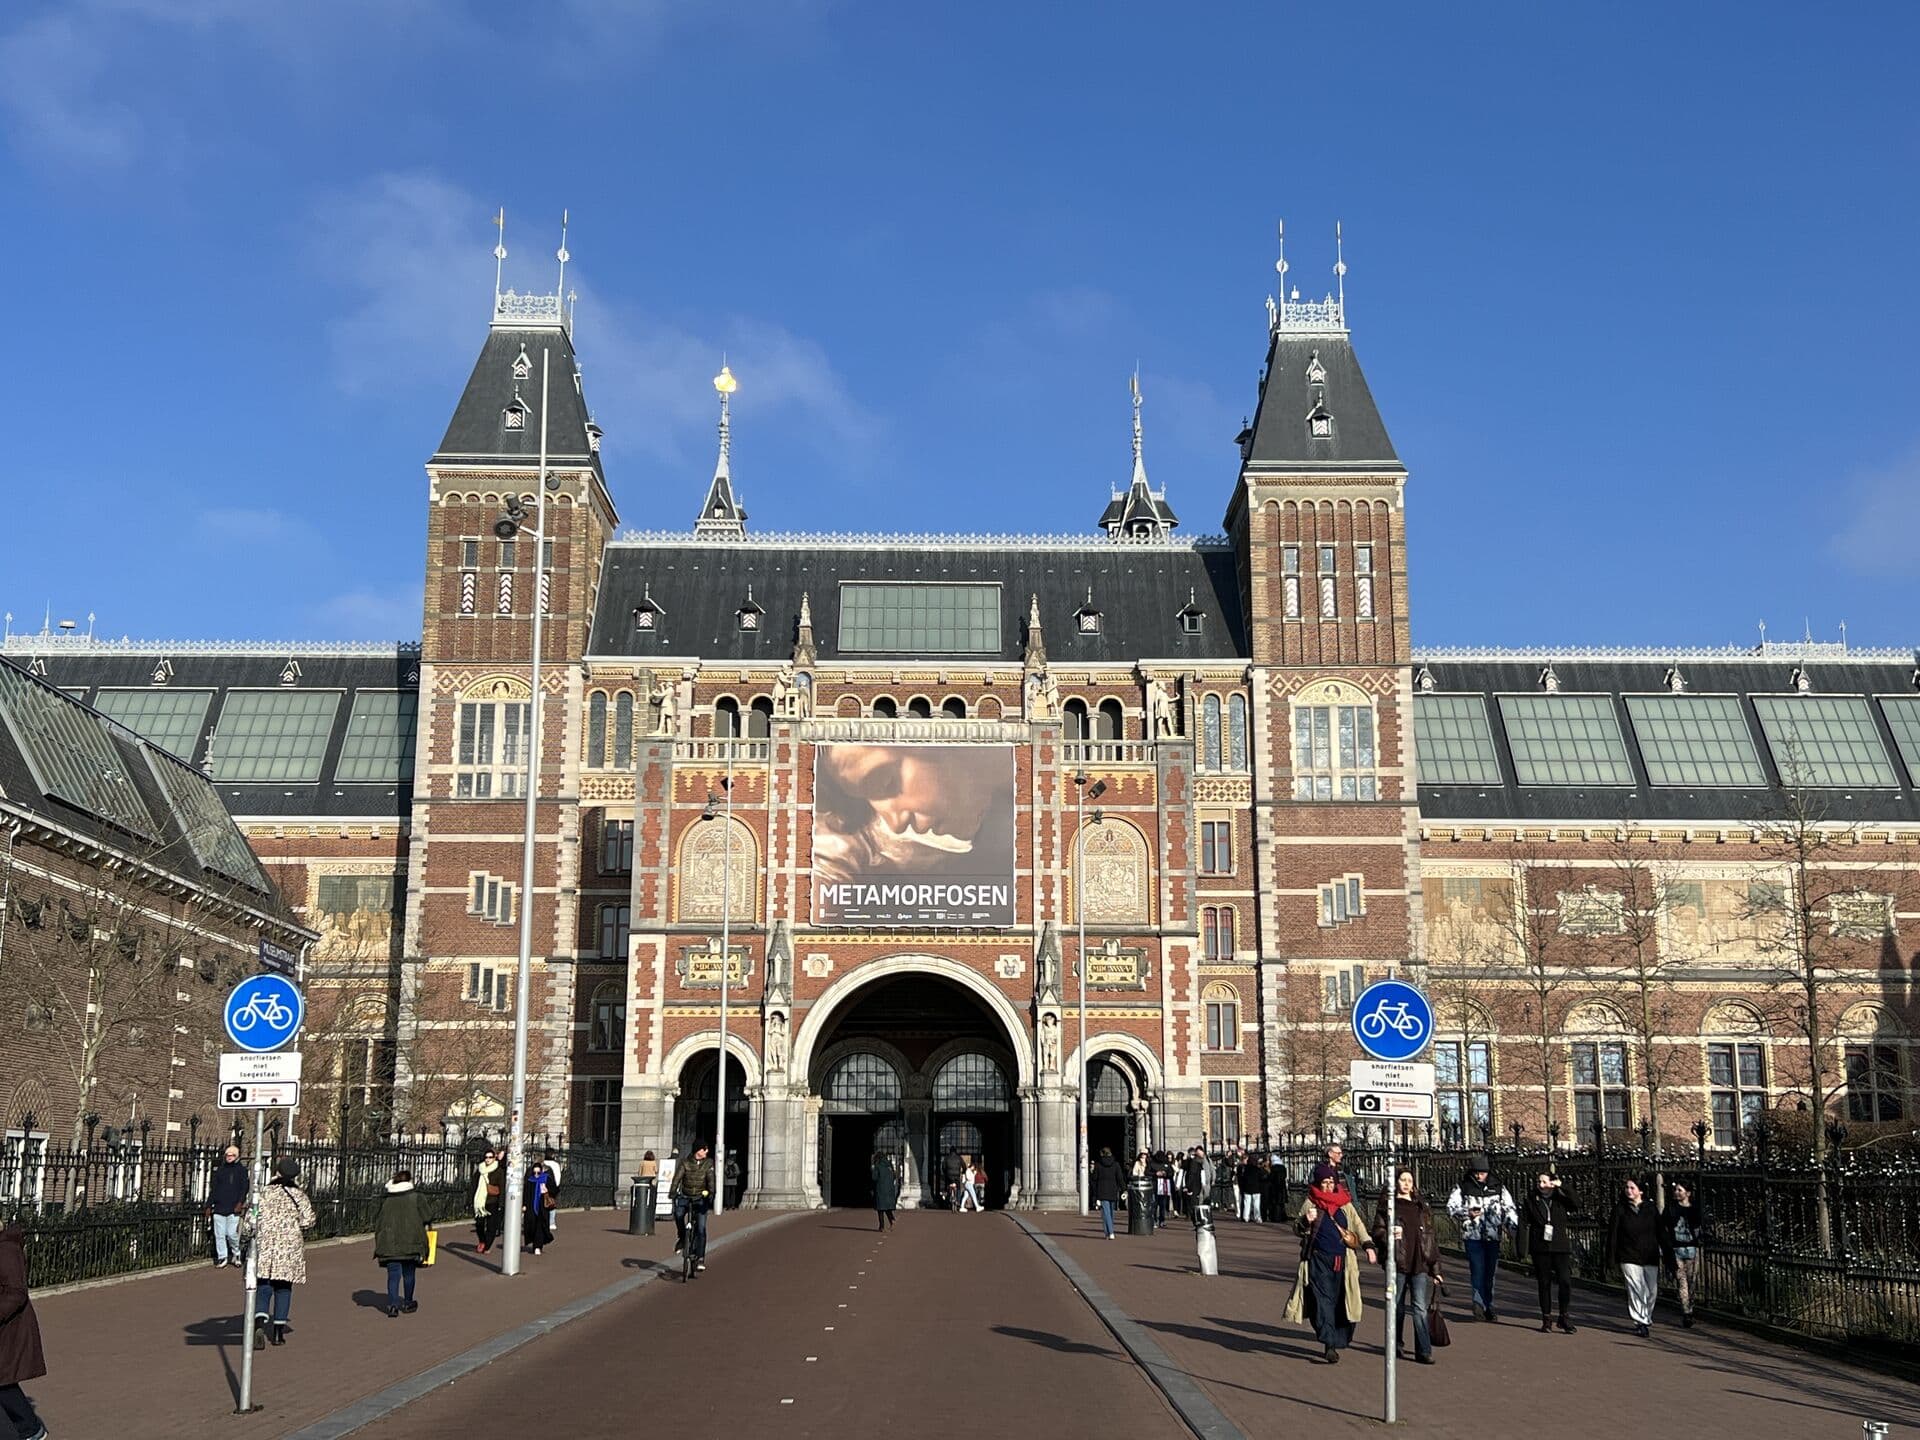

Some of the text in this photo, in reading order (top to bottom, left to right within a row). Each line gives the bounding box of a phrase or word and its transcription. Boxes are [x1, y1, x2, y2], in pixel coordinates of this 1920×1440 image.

[819, 884, 1008, 905] METAMORFOSEN
[1371, 1063, 1414, 1071] snorfietsen
[1372, 1080, 1414, 1088] toegestaan
